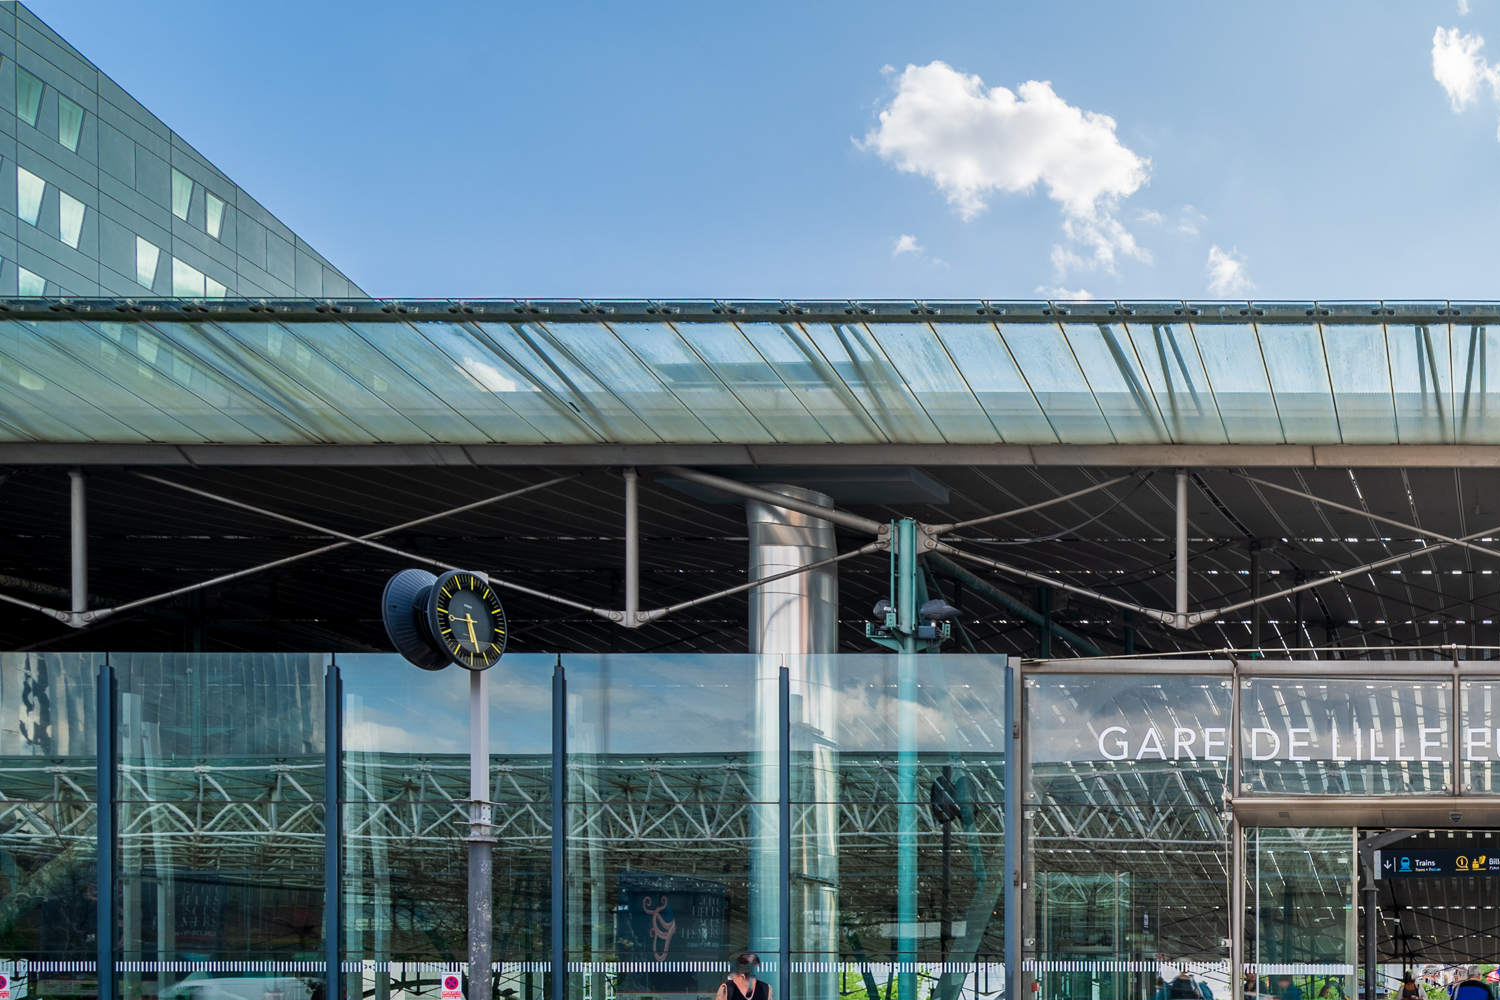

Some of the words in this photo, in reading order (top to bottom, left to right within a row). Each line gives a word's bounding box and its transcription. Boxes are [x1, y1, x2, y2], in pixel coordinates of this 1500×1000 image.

[1098, 726, 1226, 761] GARE
[1251, 727, 1310, 761] DE
[1332, 727, 1442, 761] LILLE
